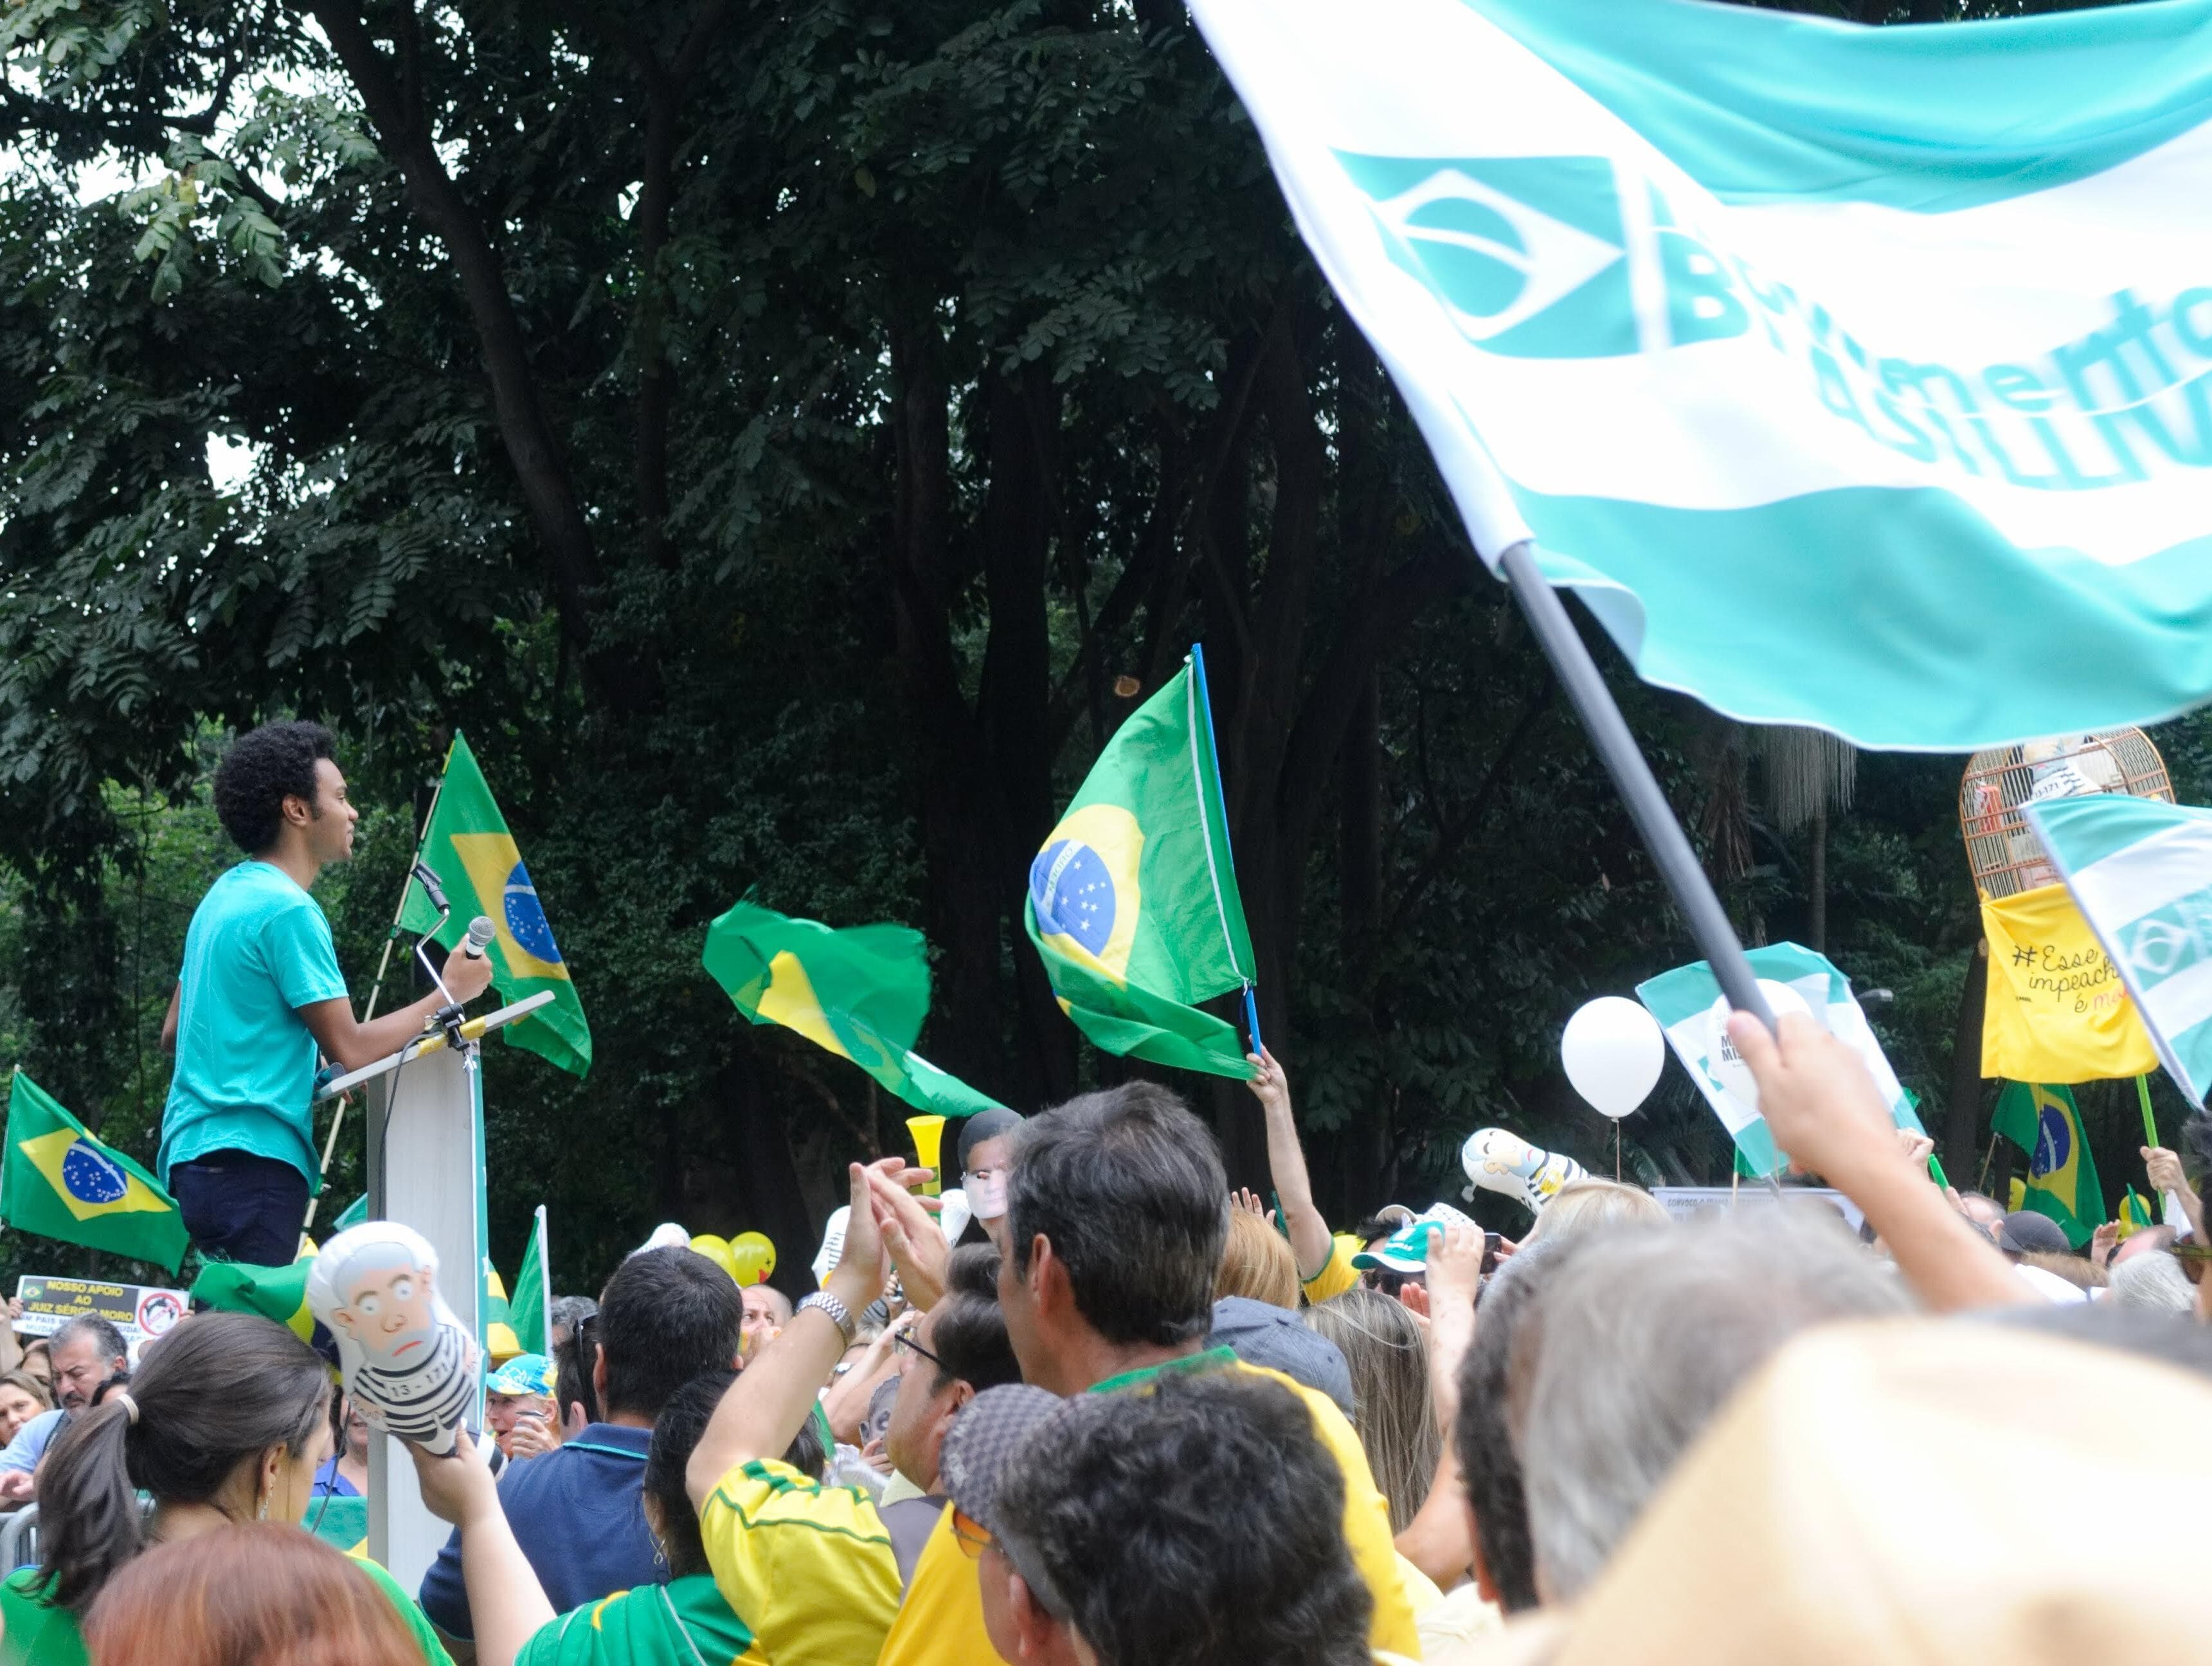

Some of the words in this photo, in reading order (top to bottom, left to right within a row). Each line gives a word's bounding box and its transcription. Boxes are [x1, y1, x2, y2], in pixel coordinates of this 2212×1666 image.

[46, 1280, 87, 1293] NOSSO
[87, 1285, 124, 1298] APOIO
[73, 1294, 93, 1305] AO
[28, 1302, 55, 1313] JUIZ
